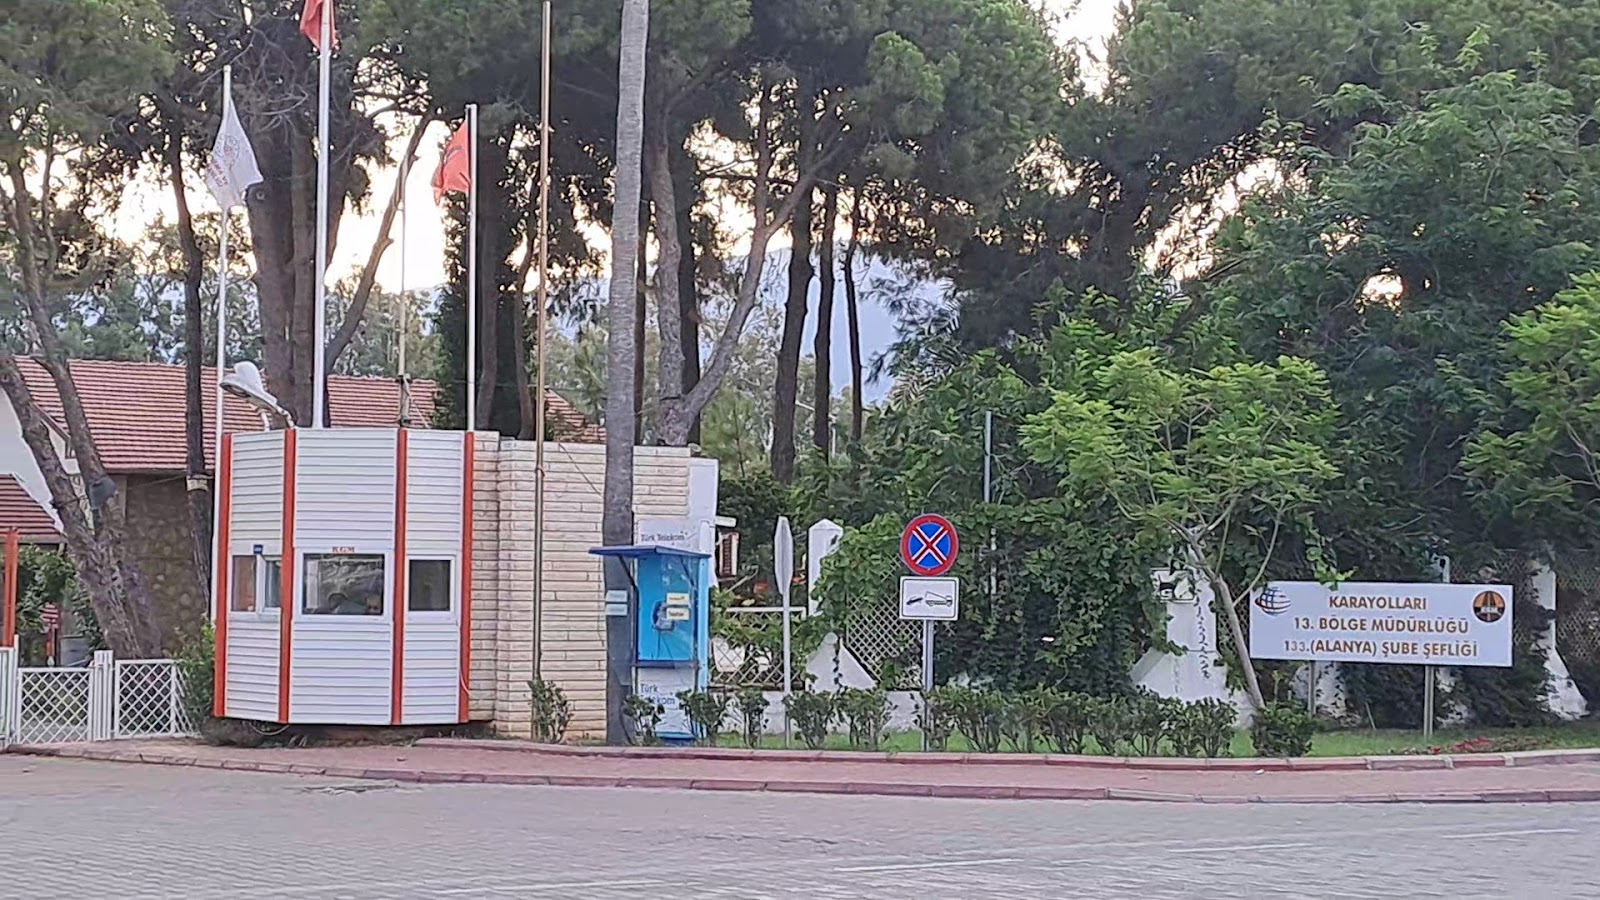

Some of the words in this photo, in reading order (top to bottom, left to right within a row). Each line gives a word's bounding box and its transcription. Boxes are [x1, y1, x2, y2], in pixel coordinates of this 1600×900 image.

[1329, 595, 1427, 610] KARAYOLLARI
[1295, 617, 1314, 630] 13.
[1319, 614, 1367, 631] BÖLGE
[1371, 615, 1468, 634] MÜDÜRLÜĞÜ
[1285, 639, 1377, 657] 133.(ALANYA)
[1382, 641, 1418, 658] ŞUBE
[1423, 640, 1477, 659] ŞEFLİĞİ
